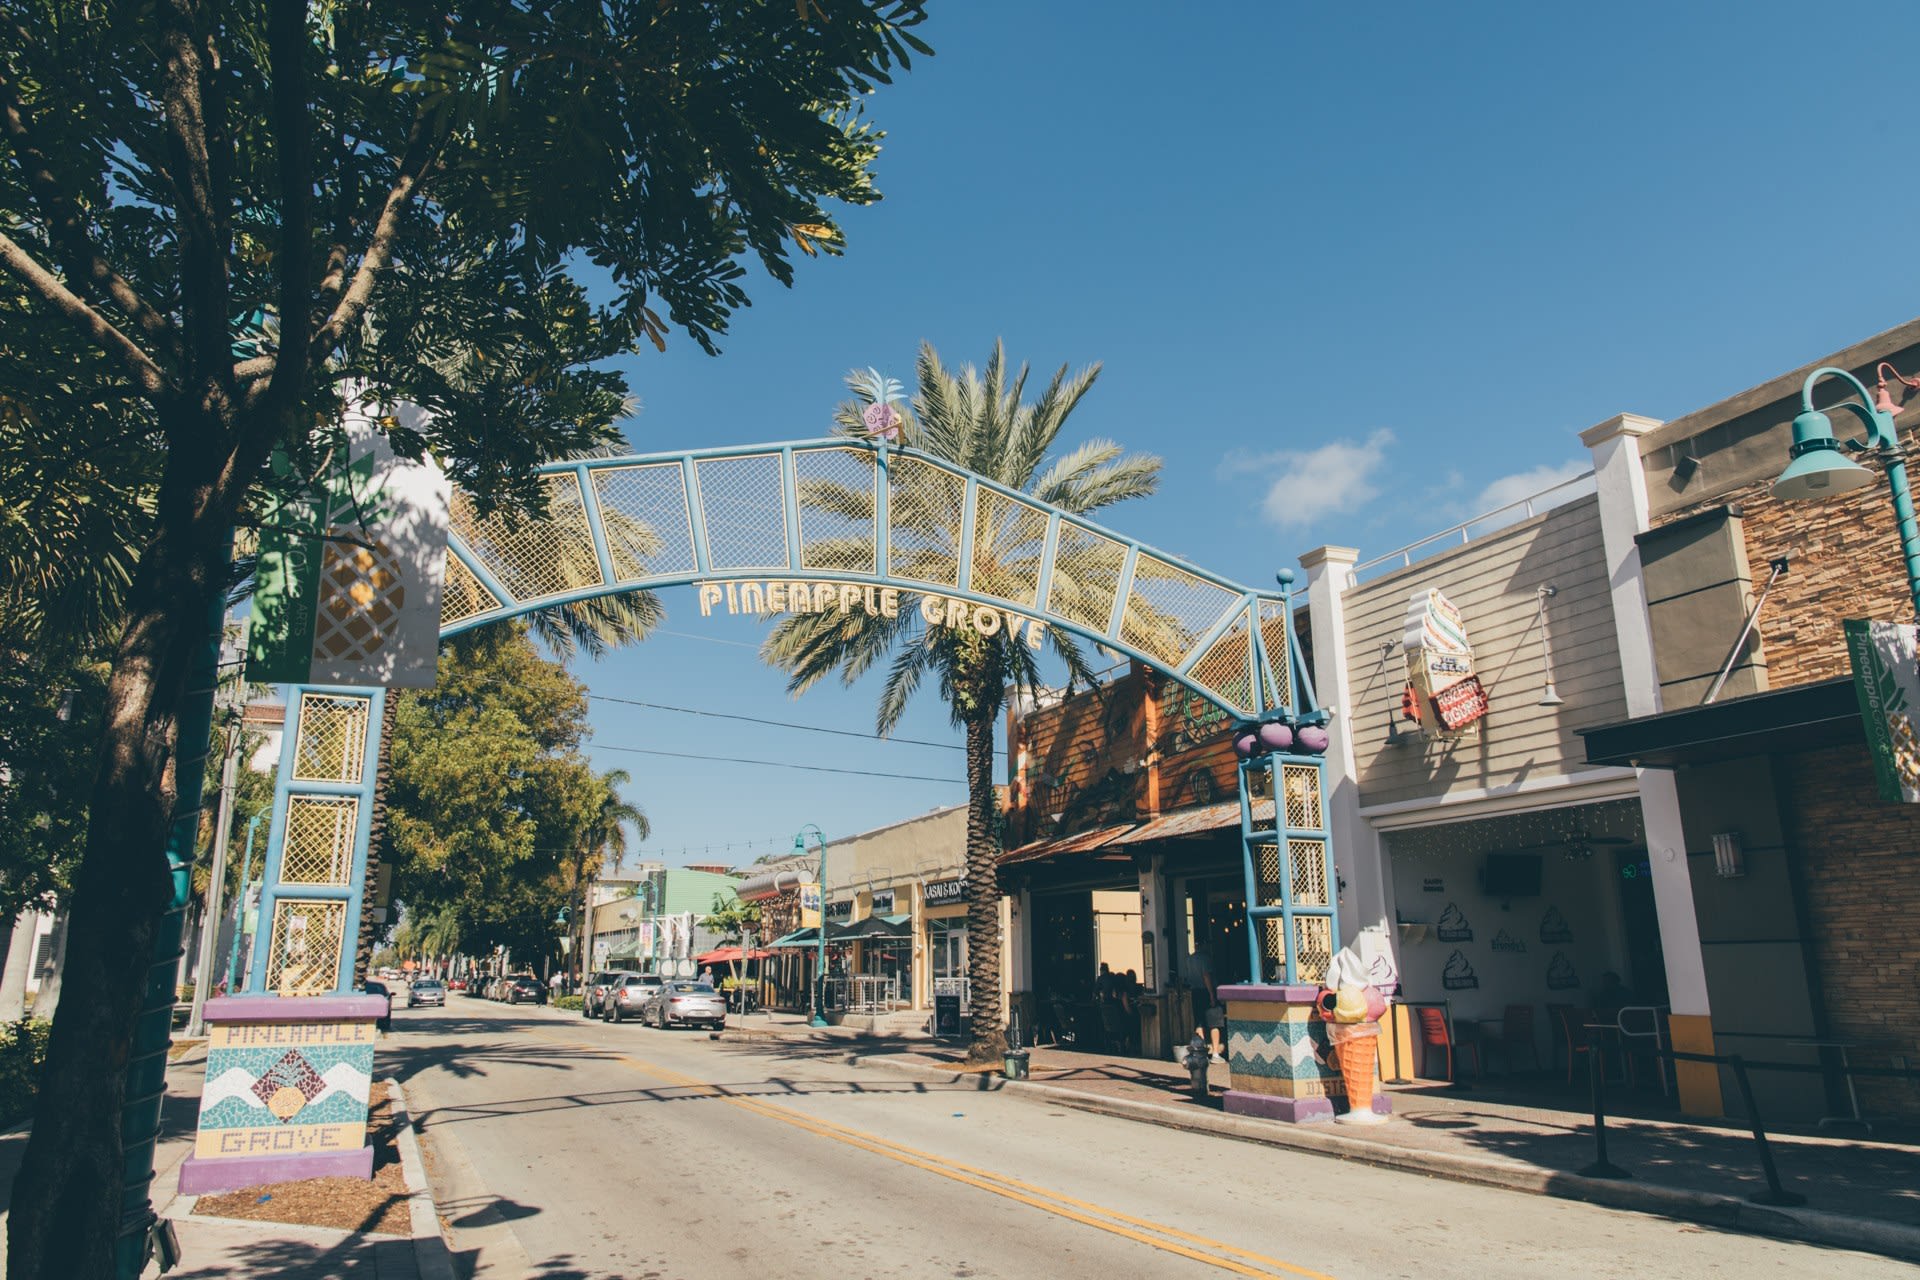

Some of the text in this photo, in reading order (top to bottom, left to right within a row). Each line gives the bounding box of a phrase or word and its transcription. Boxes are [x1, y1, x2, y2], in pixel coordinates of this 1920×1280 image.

[294, 604, 308, 637] ARTS
[699, 583, 1045, 649] PINEAPPLE GROVE
[1855, 632, 1880, 709] Pineapple
[227, 1024, 366, 1044] PINEAPPLE
[221, 1128, 341, 1153] GROVE
